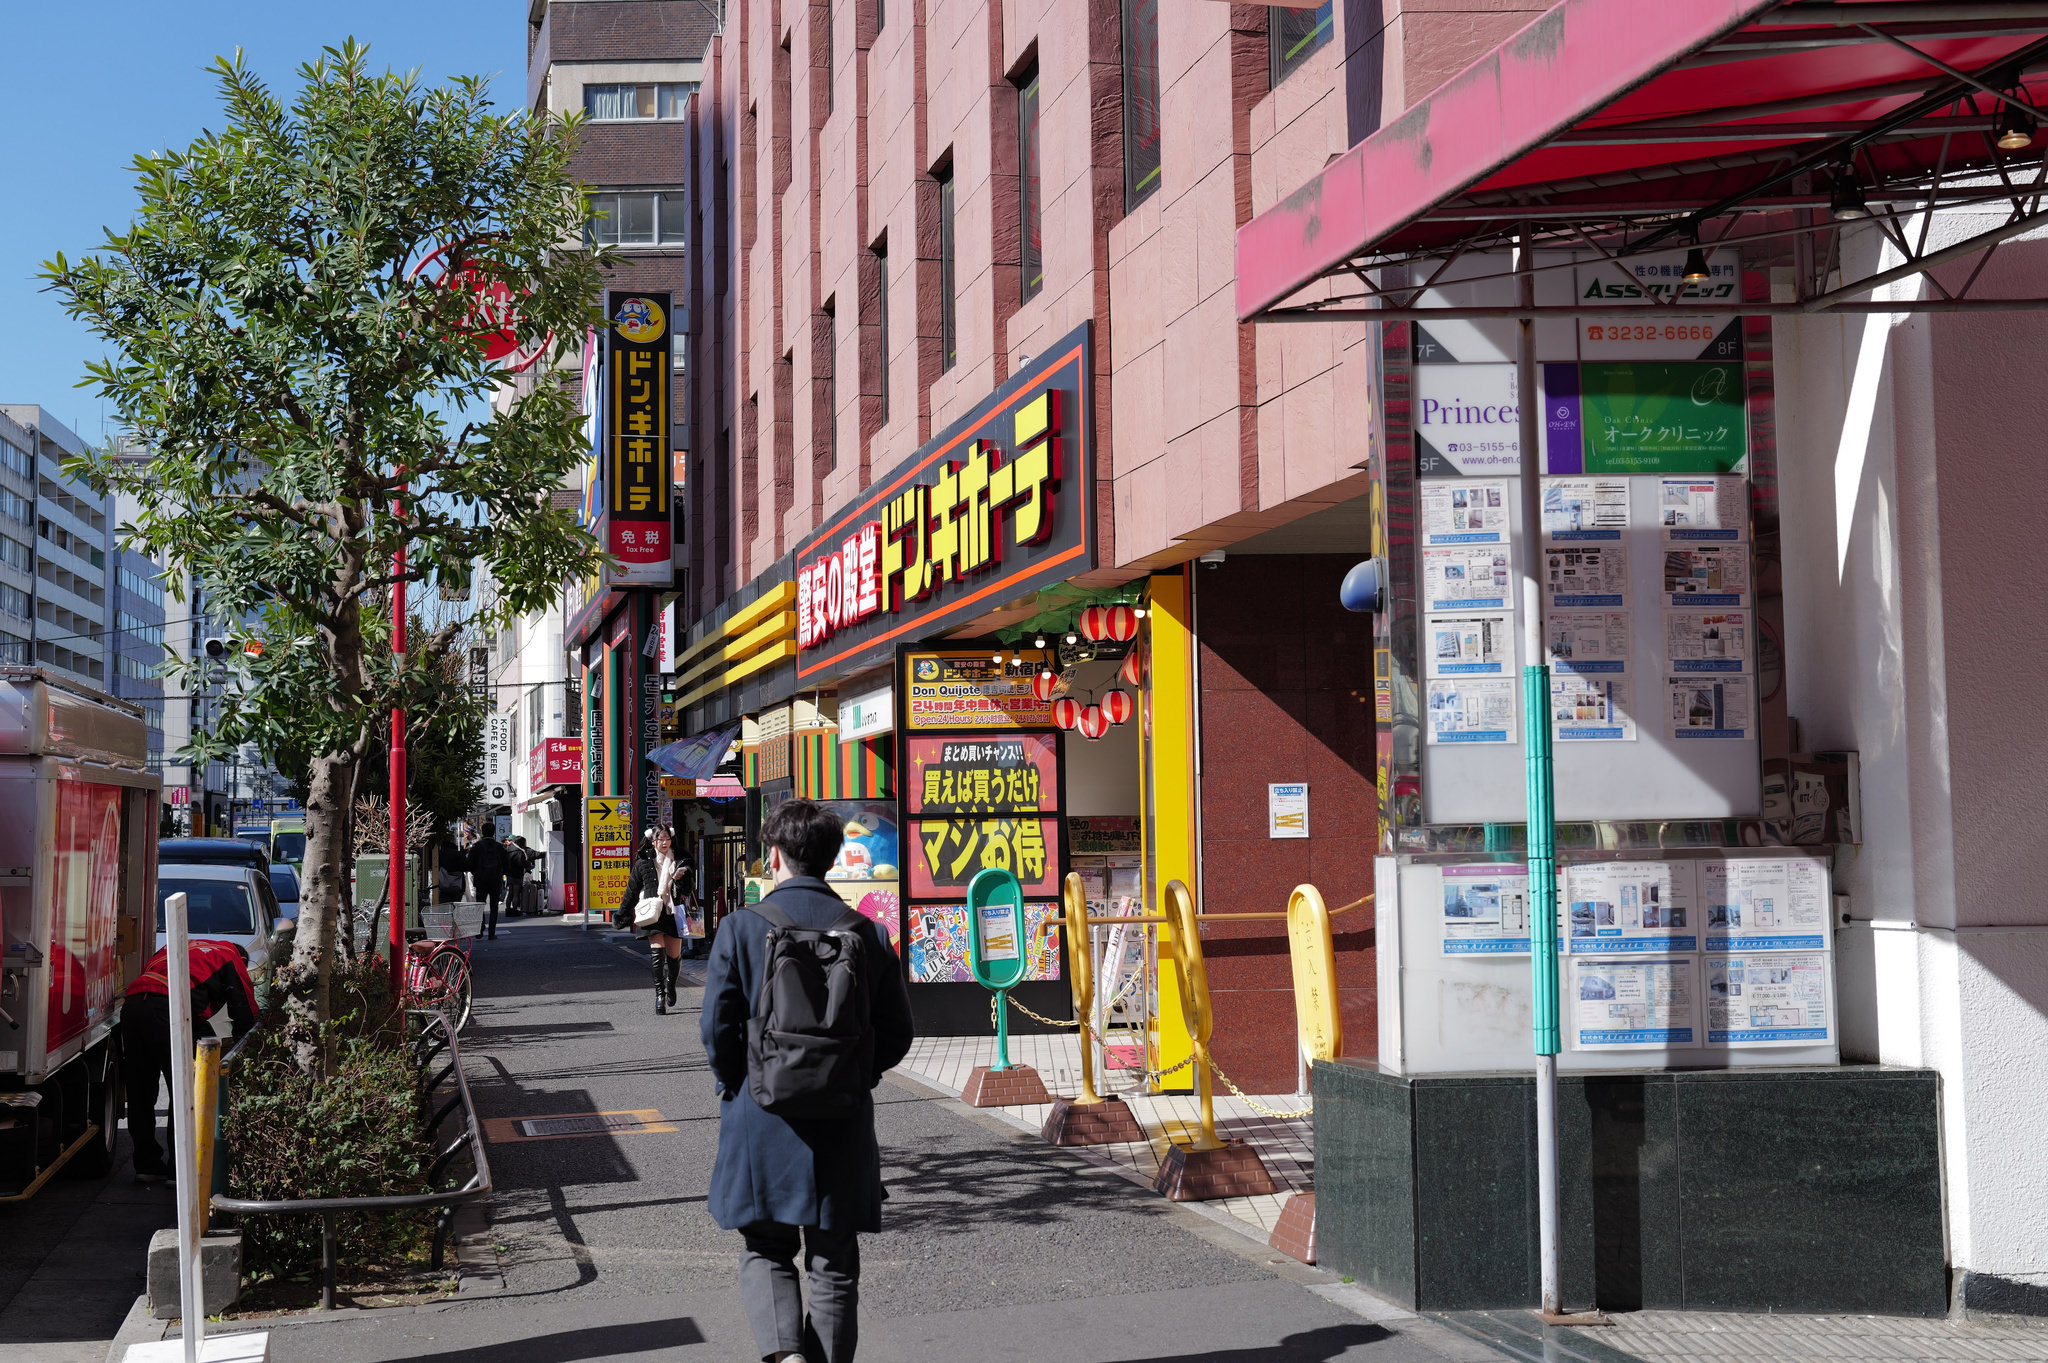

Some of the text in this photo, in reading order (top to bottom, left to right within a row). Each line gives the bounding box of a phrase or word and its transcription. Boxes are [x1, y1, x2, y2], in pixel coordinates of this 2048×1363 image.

[1635, 265, 1734, 277] 性の機能専門
[1608, 326, 1713, 340] 3232-6666
[1416, 344, 1436, 357] 7F
[1718, 342, 1737, 355] 8F
[1420, 457, 1439, 471] 5F
[912, 686, 936, 697] Don
[939, 686, 980, 698] Quijote
[914, 715, 937, 725] Open
[938, 715, 948, 723] 24
[949, 715, 971, 723] Hours
[490, 718, 498, 741] CAFE
[490, 752, 498, 775] BEER
[923, 768, 1039, 805] 買えば買うだけ
[920, 805, 1047, 880] マジお得
